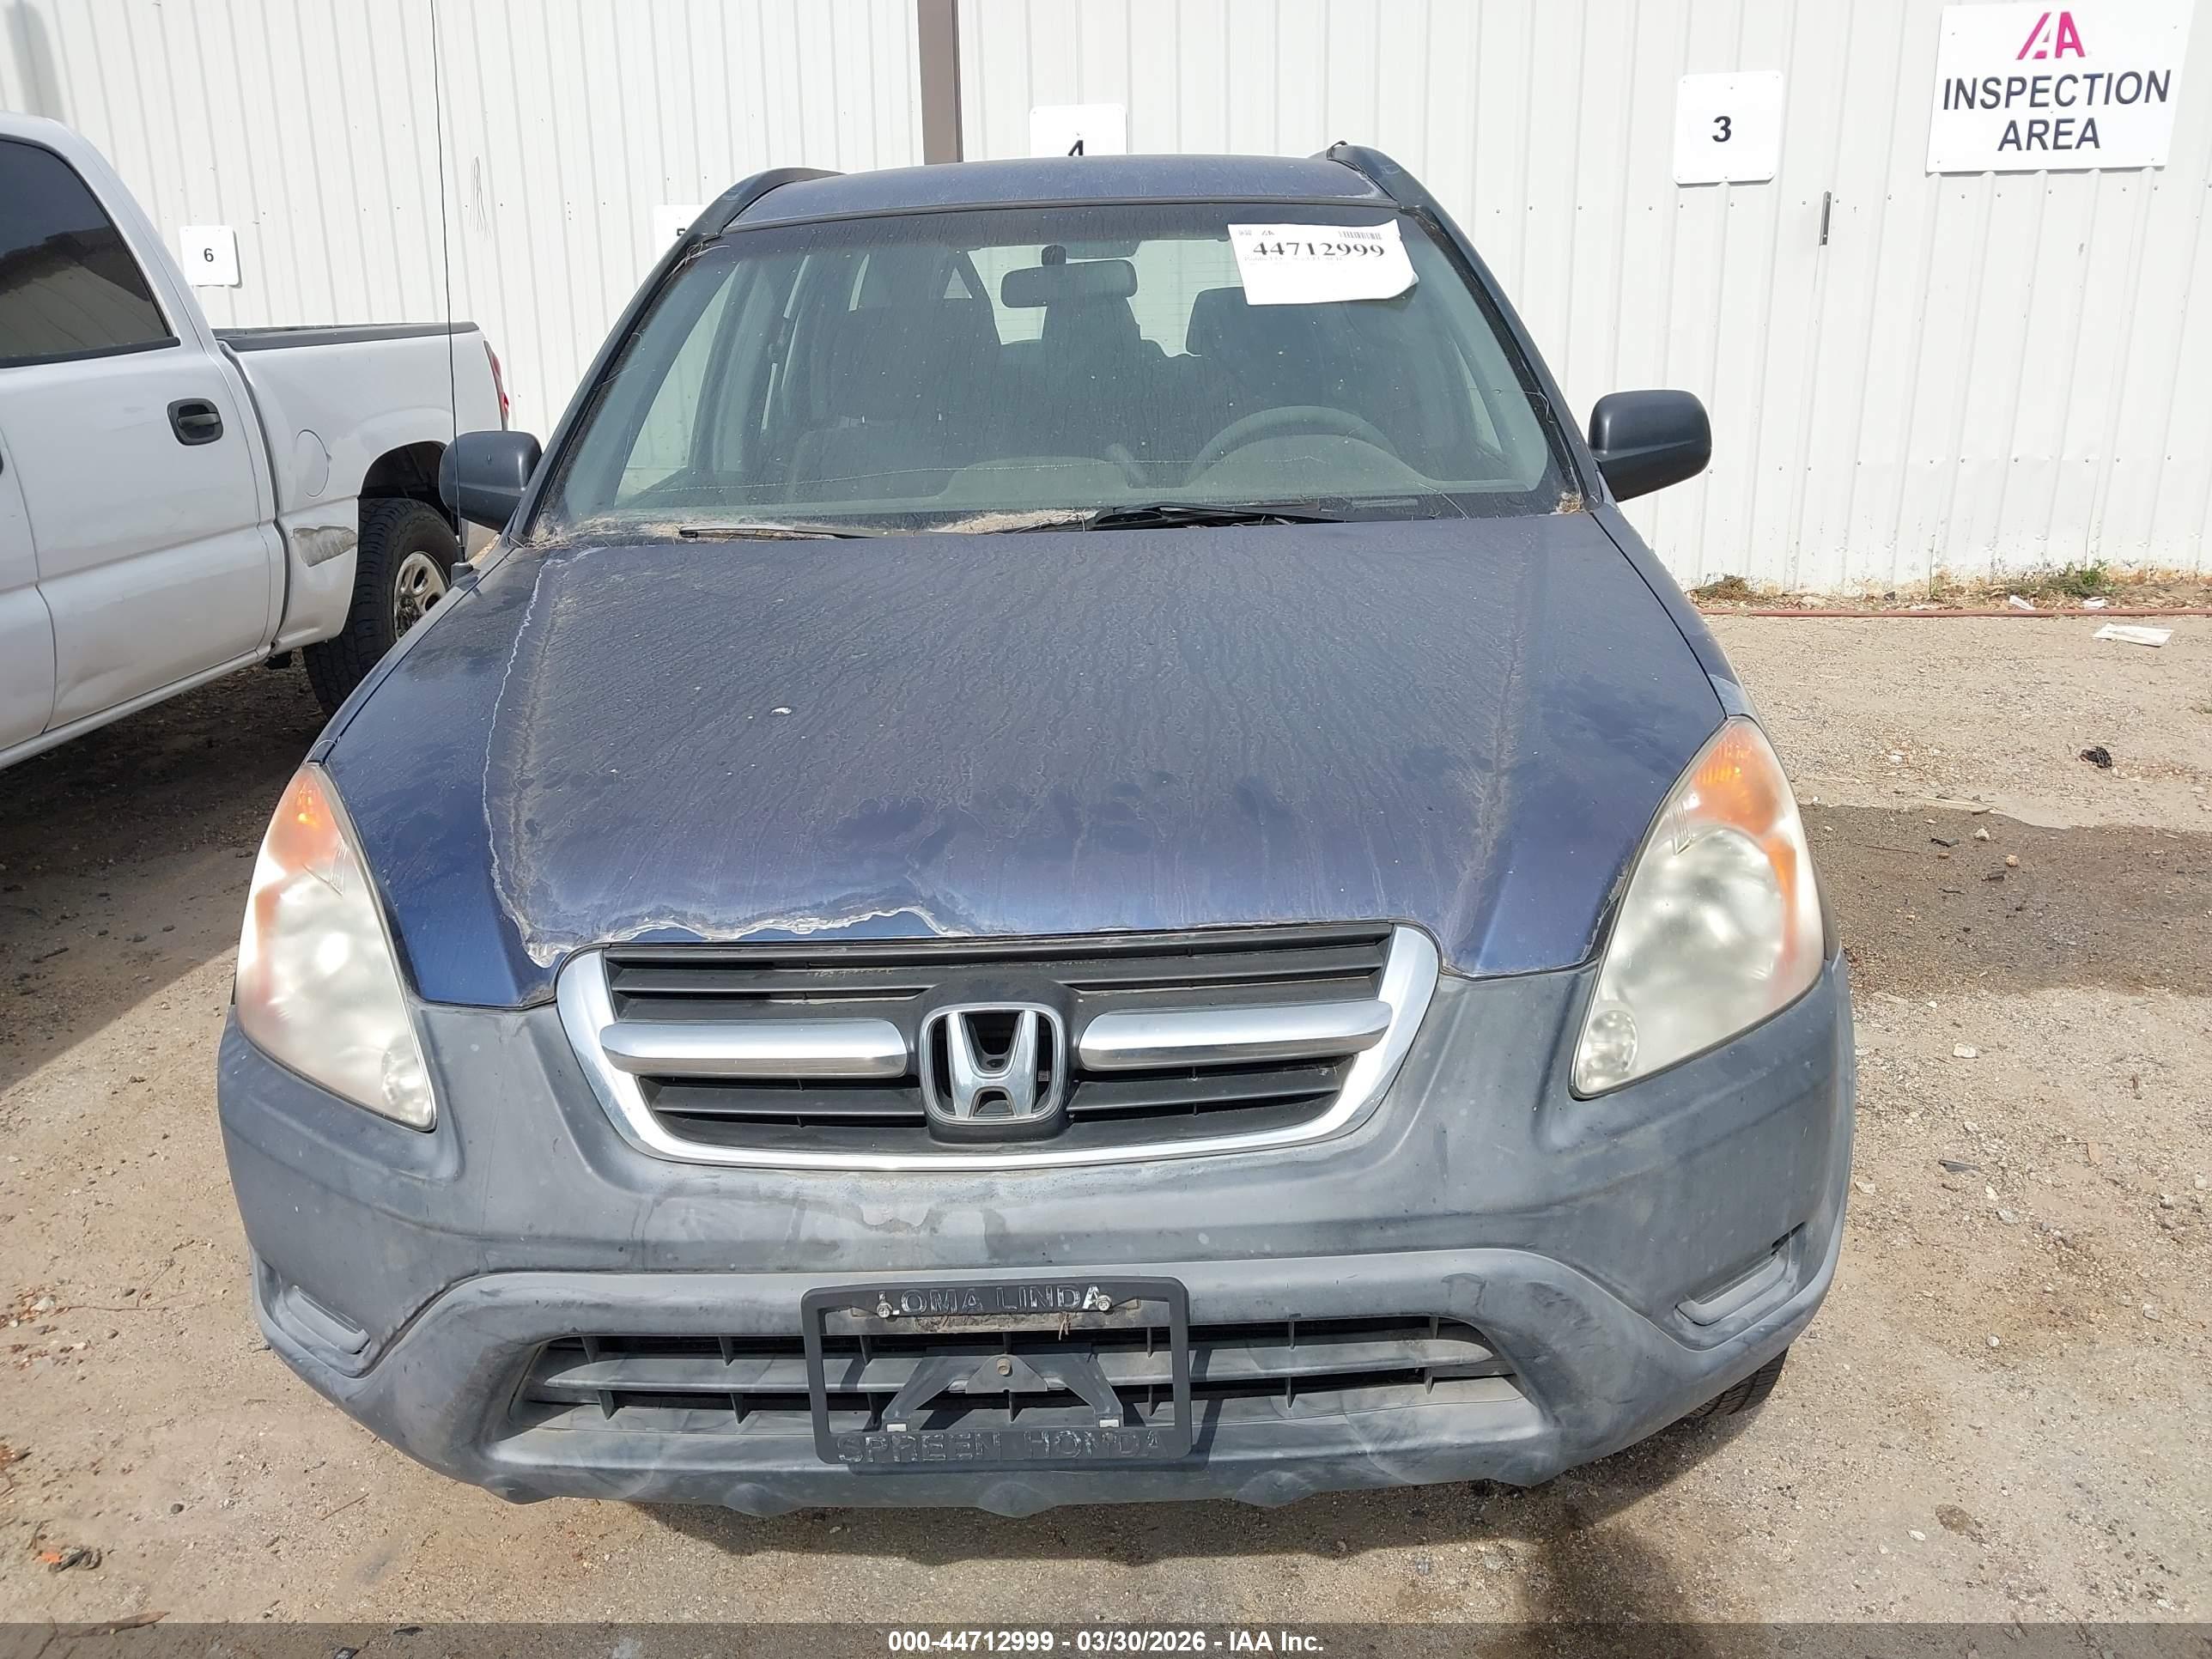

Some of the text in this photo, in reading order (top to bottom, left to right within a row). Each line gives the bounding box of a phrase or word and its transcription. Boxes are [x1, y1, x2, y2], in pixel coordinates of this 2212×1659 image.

[1943, 70, 2171, 111] INSPECTION
[1711, 115, 1732, 143] 3
[1997, 118, 2100, 152] AREA
[204, 247, 215, 263] 6
[1253, 241, 1385, 258] 44712999
[994, 1285, 1103, 1313] LINDA
[1024, 1429, 1166, 1459] HONDA
